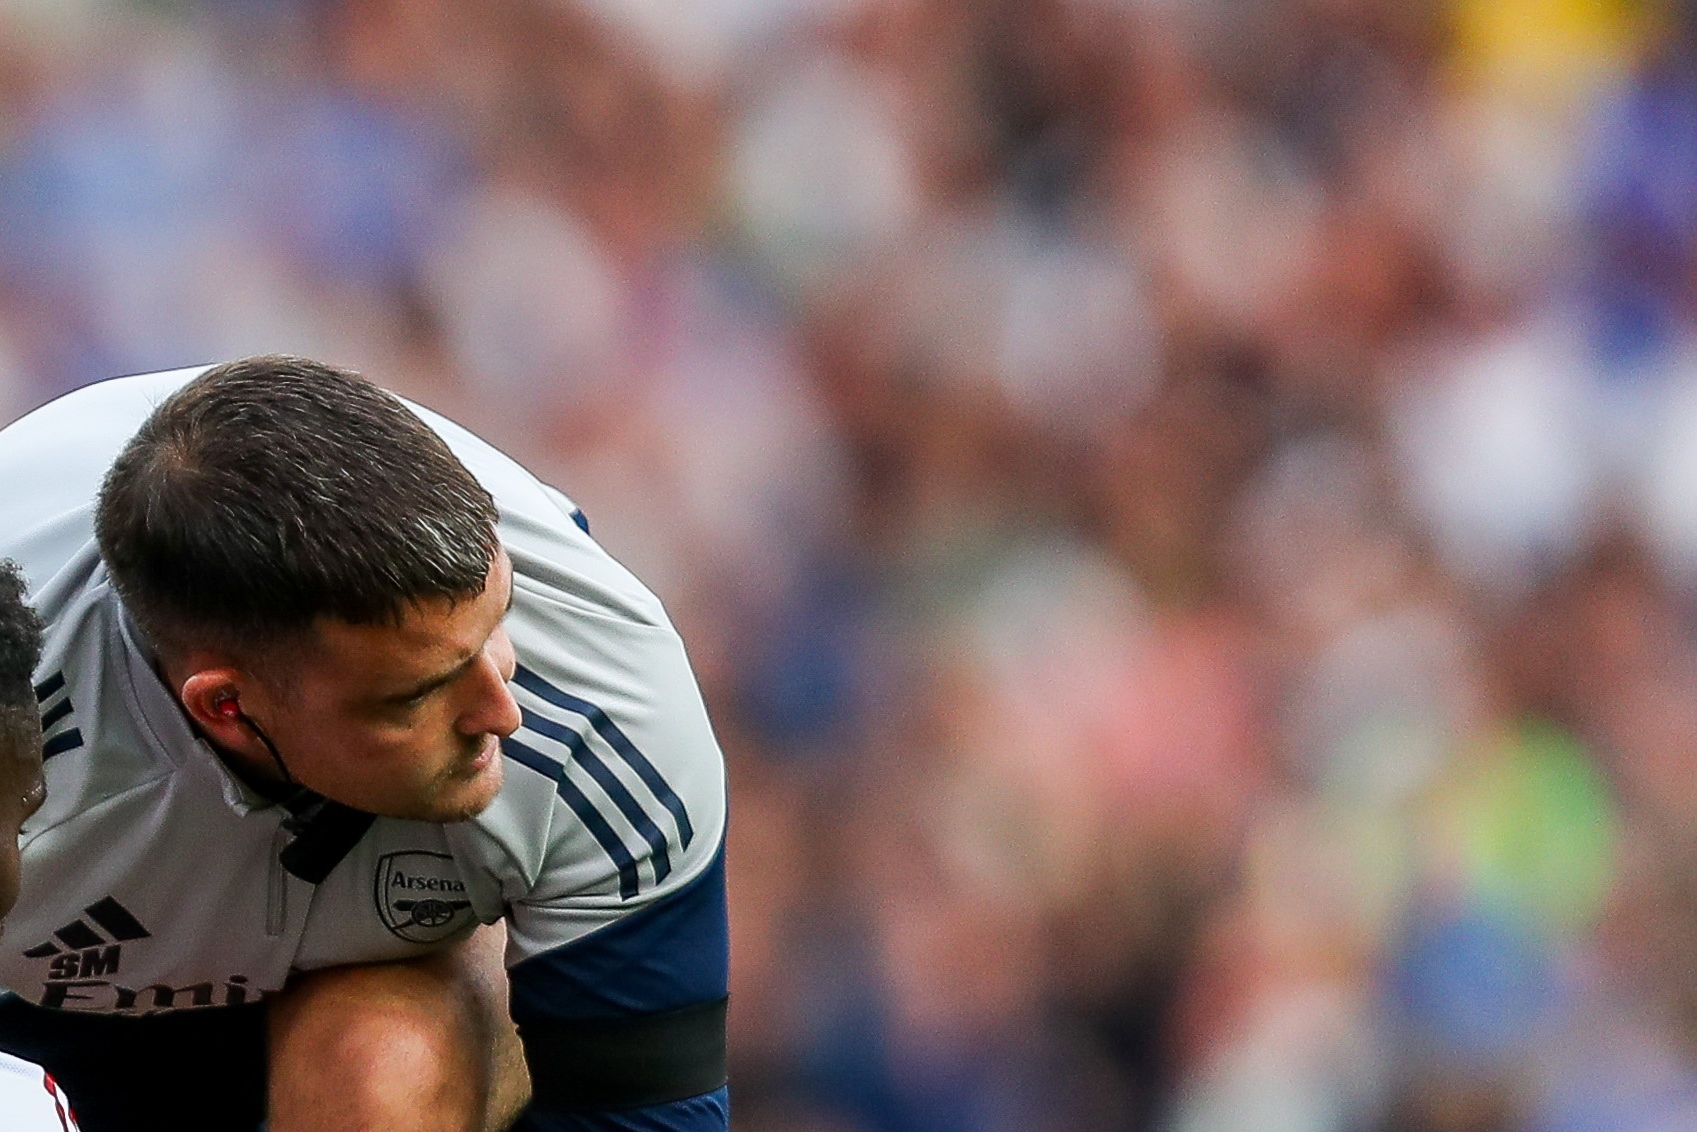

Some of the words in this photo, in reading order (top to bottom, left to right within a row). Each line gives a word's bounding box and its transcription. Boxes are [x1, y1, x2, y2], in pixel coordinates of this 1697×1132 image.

[391, 870, 465, 892] Arsena
[48, 944, 121, 978] SM
[41, 974, 282, 1009] Emi
